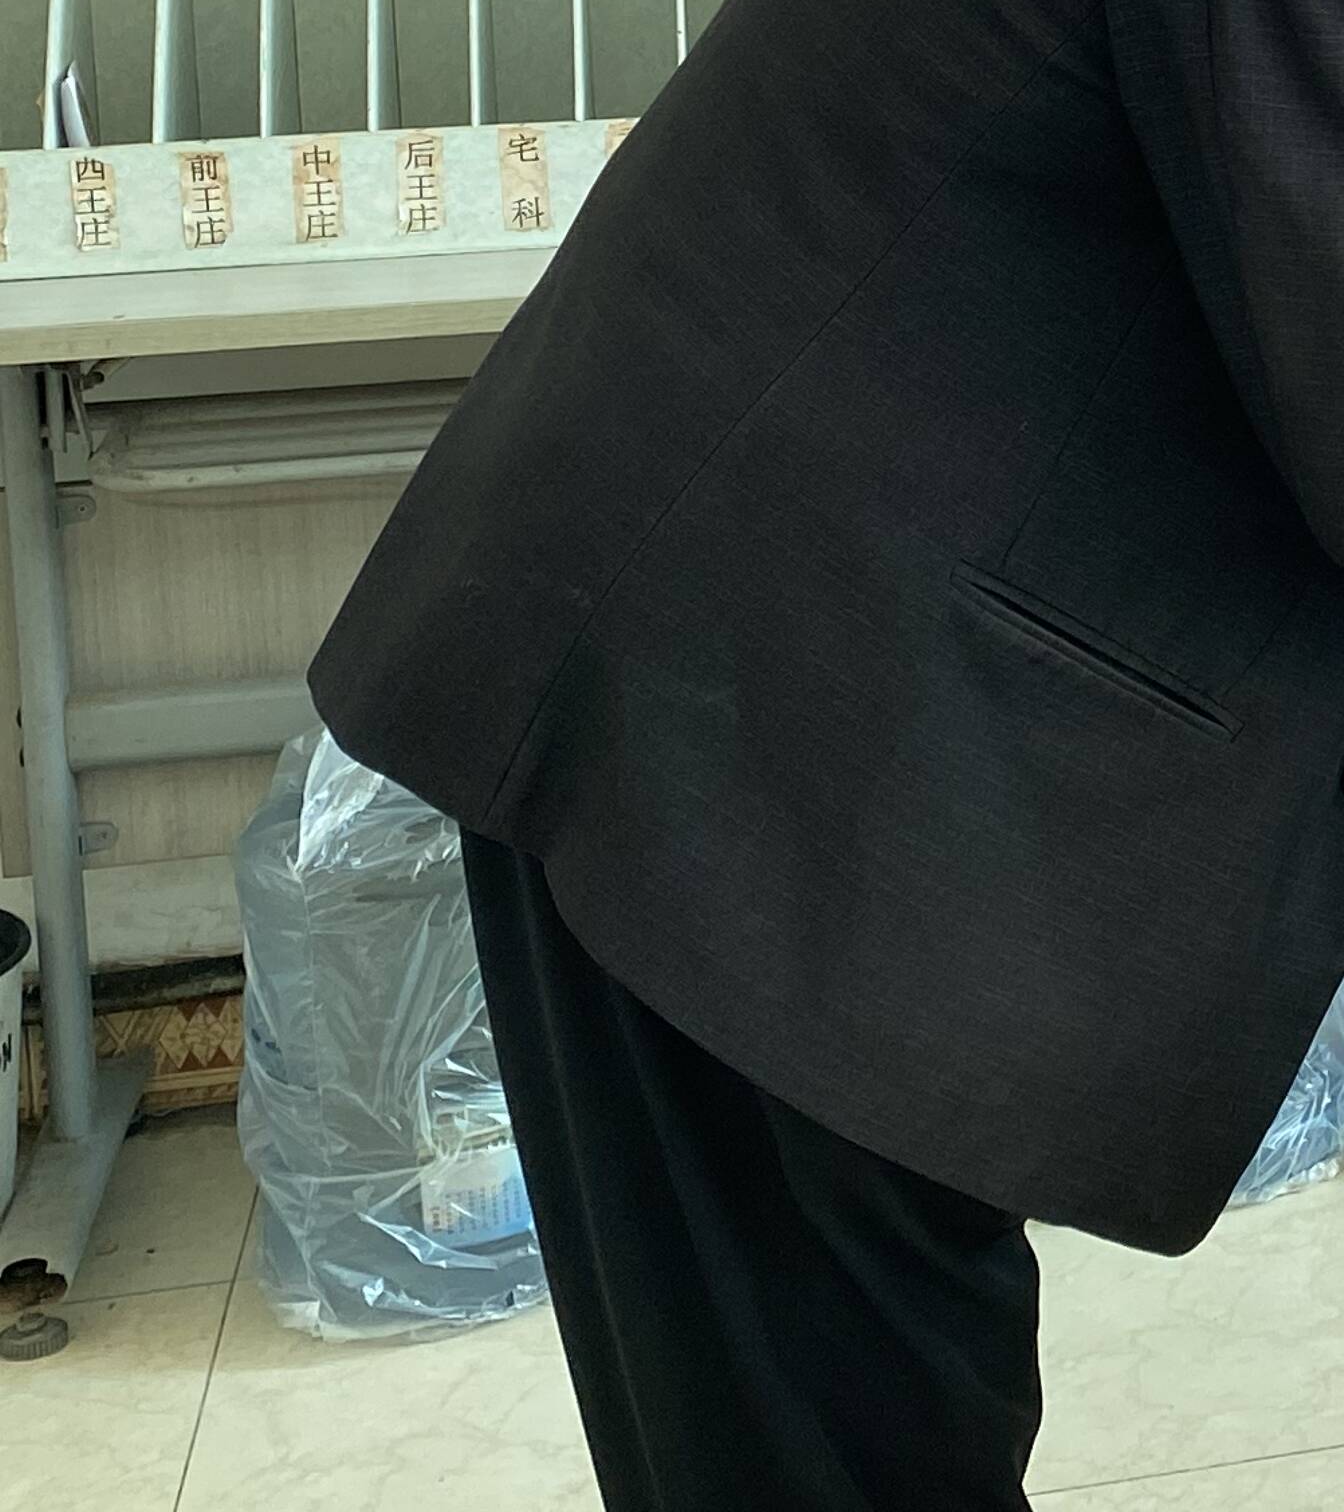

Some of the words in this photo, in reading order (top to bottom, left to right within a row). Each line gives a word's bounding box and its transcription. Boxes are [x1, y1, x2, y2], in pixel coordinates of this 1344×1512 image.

[186, 153, 227, 249] 前王庄
[302, 144, 338, 242] 中王庄
[403, 139, 438, 235] 后王庄
